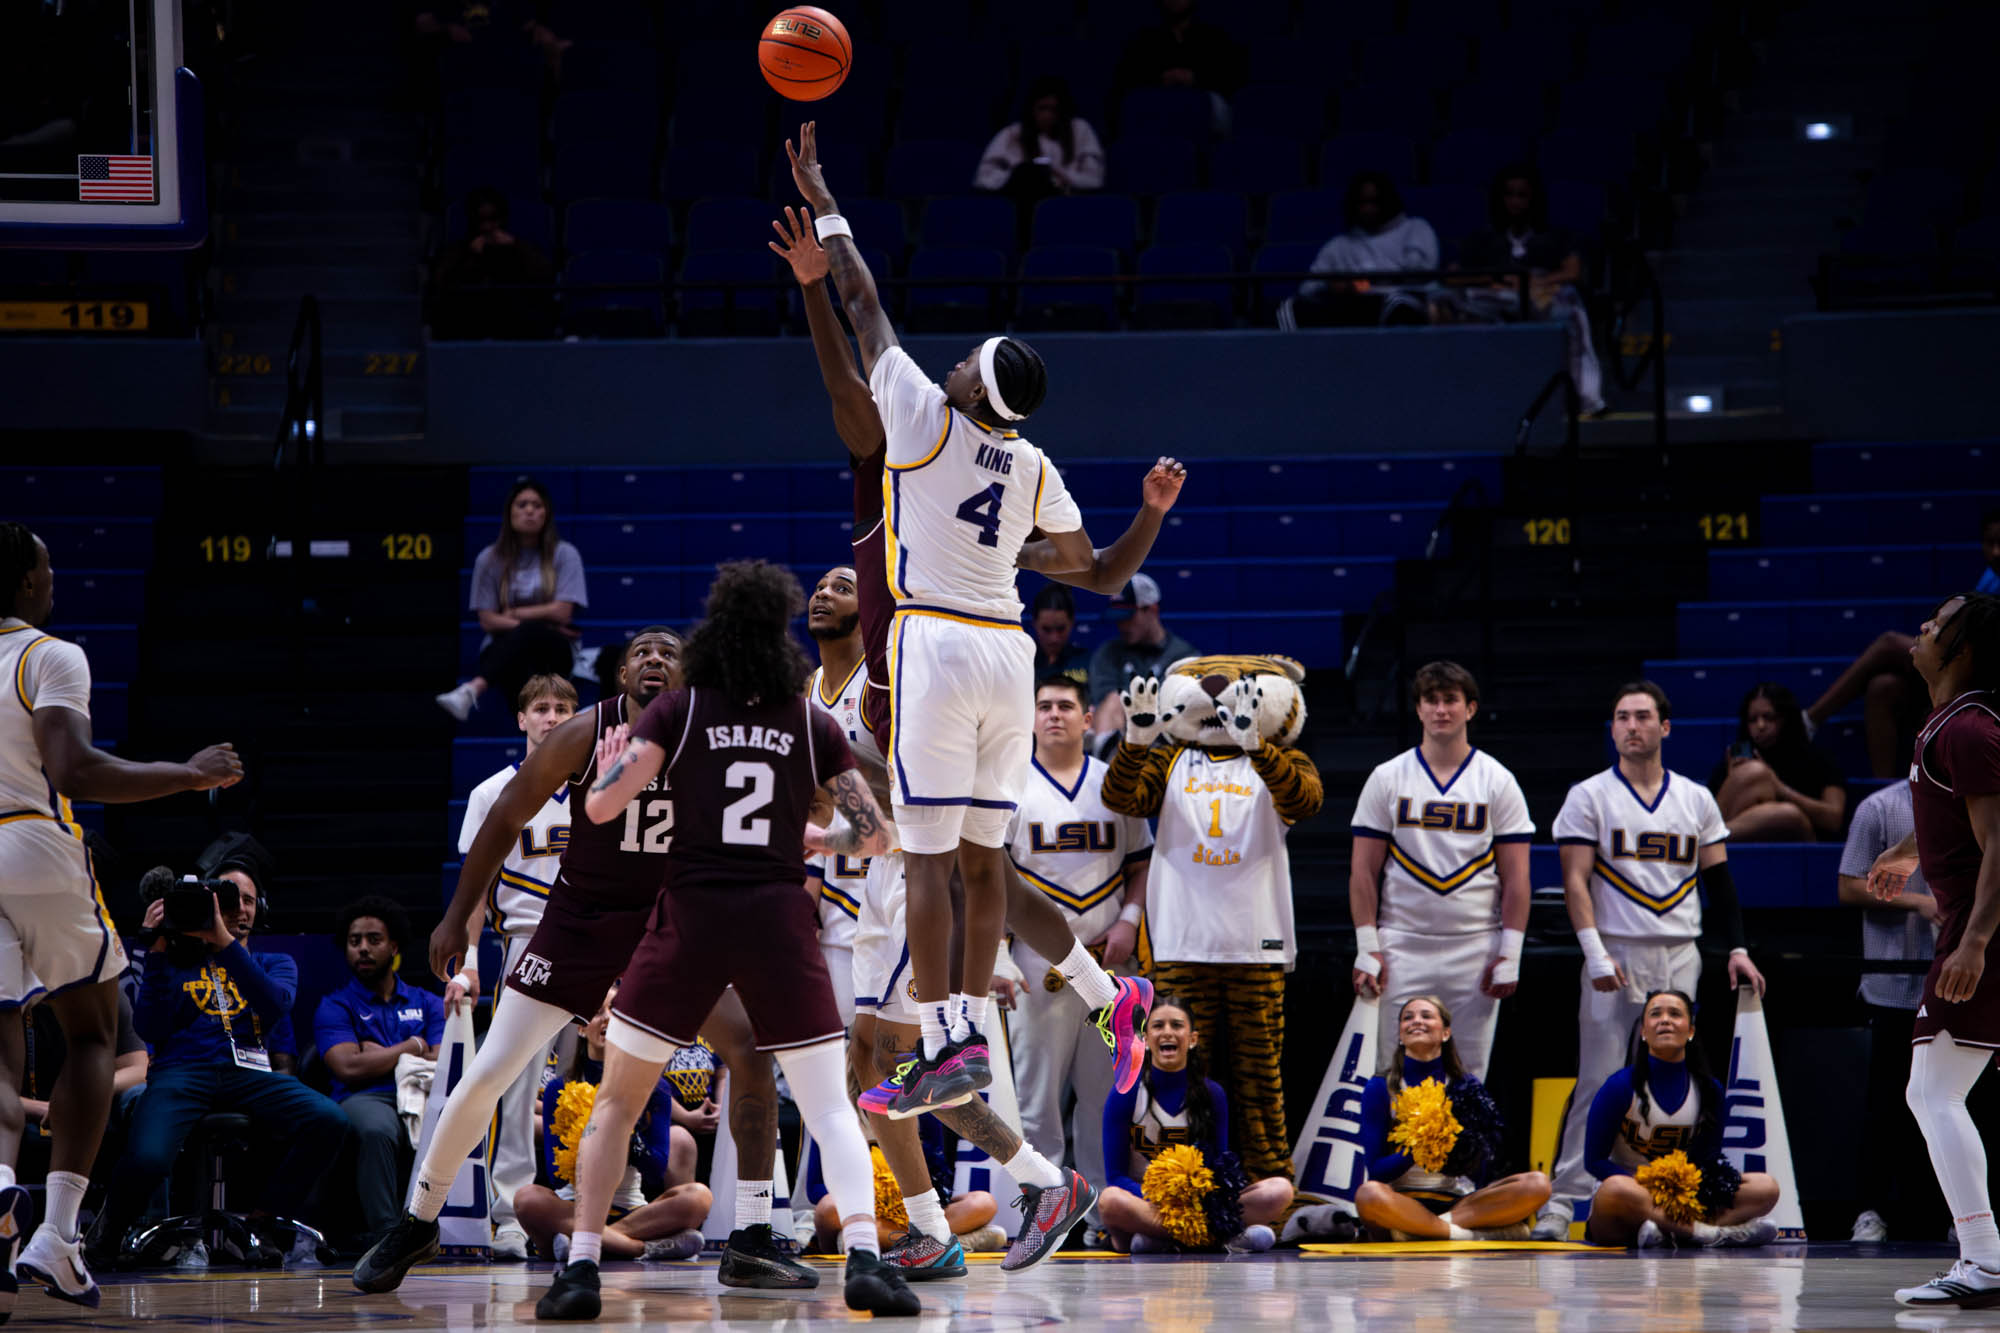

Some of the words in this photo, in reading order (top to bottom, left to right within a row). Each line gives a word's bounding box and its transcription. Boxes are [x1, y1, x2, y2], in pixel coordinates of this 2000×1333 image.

[62, 303, 134, 329] 119
[363, 352, 417, 376] 227
[975, 443, 1013, 475] KING
[956, 482, 1005, 547] 4
[1522, 517, 1571, 544] 120
[1698, 513, 1750, 541] 121
[200, 535, 252, 562] 119
[381, 532, 433, 560] 120
[705, 724, 795, 757] ISAACS
[722, 760, 775, 846] 2
[1208, 798, 1223, 837] 1
[1397, 797, 1488, 834] LSU
[519, 824, 570, 859] LS
[619, 799, 675, 854] 12
[1029, 822, 1116, 854] LSU
[1192, 843, 1241, 866] State
[1612, 829, 1697, 865] LSU
[1722, 1036, 1766, 1173] LS
[1130, 1125, 1189, 1156] LS
